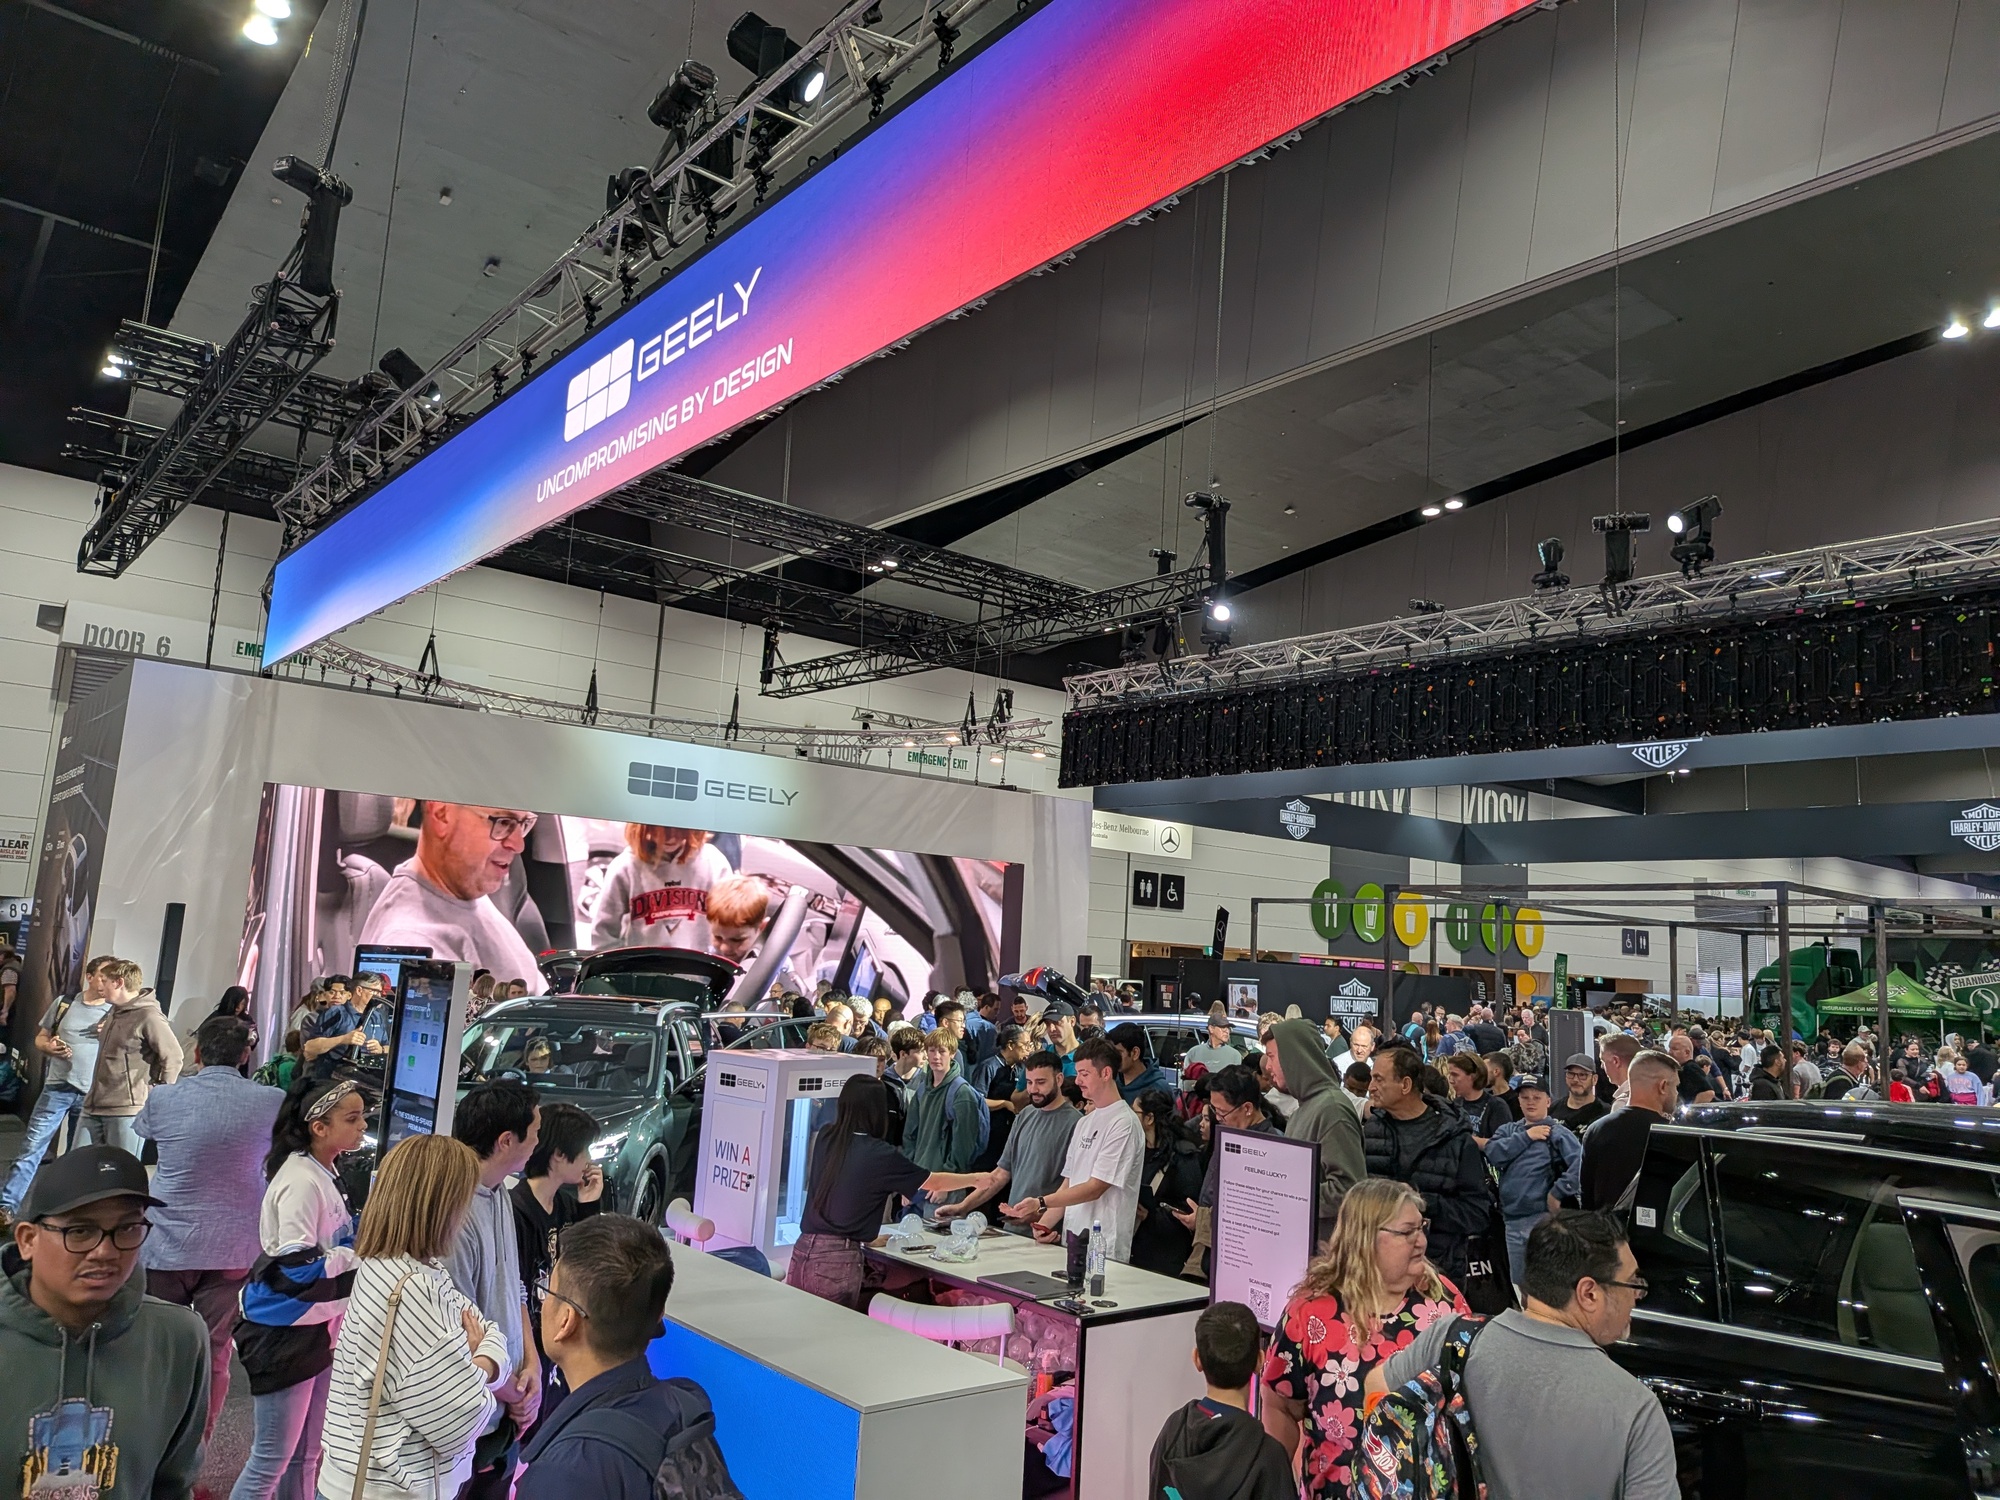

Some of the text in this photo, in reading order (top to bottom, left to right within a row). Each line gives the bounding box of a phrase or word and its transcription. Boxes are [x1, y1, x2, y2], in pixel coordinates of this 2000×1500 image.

[637, 266, 762, 382] GEELY
[536, 337, 793, 503] UNCOMPROMISING BY DESIGN
[83, 623, 171, 657] DOOR 6
[907, 751, 969, 771] EMERGENCY EXIT
[1638, 744, 1680, 764] CYCLES
[704, 779, 799, 806] GEELY
[1119, 824, 1150, 836] Melbourne
[631, 889, 708, 918] DIVISION
[1343, 982, 1367, 996] MOTOR
[1951, 973, 2000, 988] SHANNONS
[1332, 998, 1377, 1014] HARLEY-DAVIDSON
[737, 1078, 762, 1089] GEELY
[715, 1139, 751, 1166] WIN A
[1242, 1147, 1268, 1158] GEELY
[1244, 1165, 1288, 1180] FEELING LUCKY?
[1466, 1259, 1493, 1277] EN
